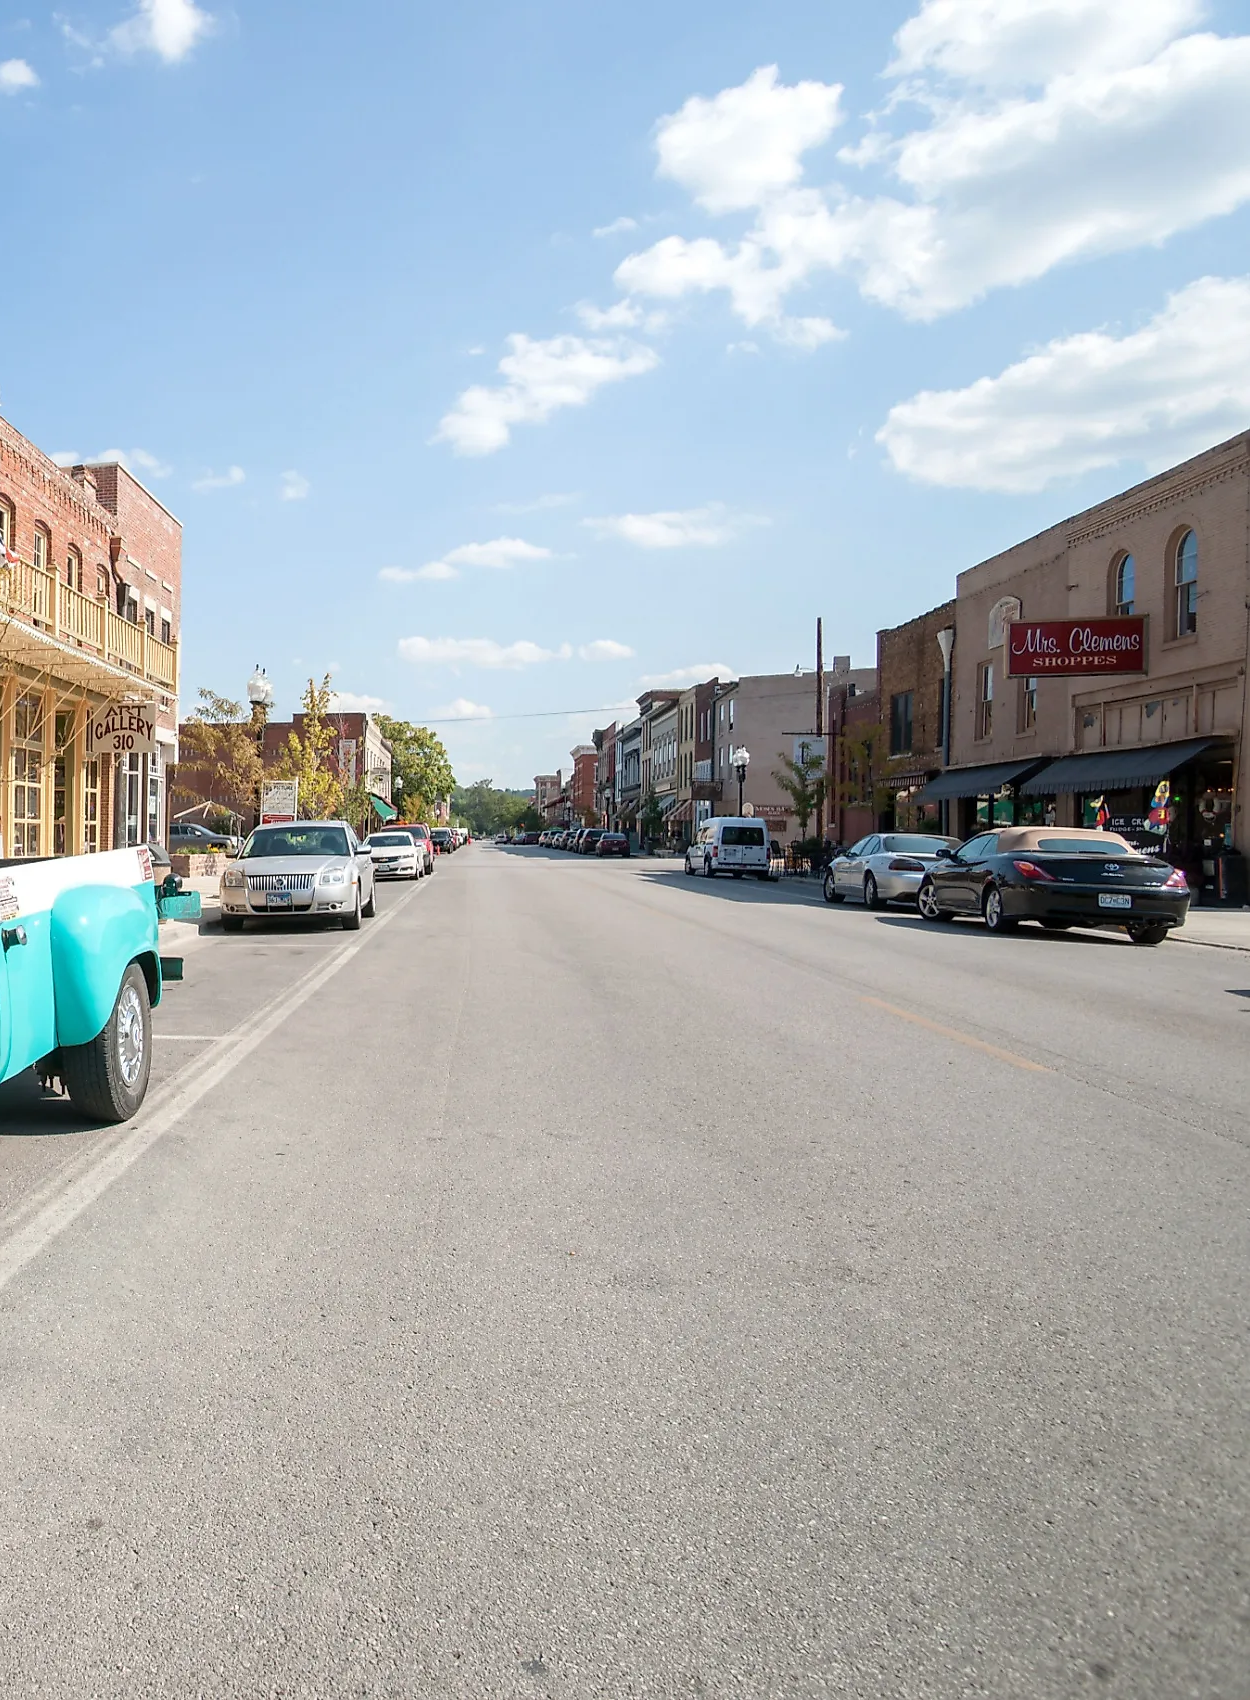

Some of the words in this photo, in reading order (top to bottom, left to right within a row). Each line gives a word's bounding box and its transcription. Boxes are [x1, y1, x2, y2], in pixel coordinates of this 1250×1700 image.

[1011, 628, 1061, 655] Mrs.
[1068, 627, 1140, 654] Clemens
[1032, 655, 1118, 667] SHOPPES
[104, 705, 147, 719] ART
[95, 715, 153, 741] GALLERY
[112, 733, 134, 750] 310
[1111, 818, 1125, 826] ICE
